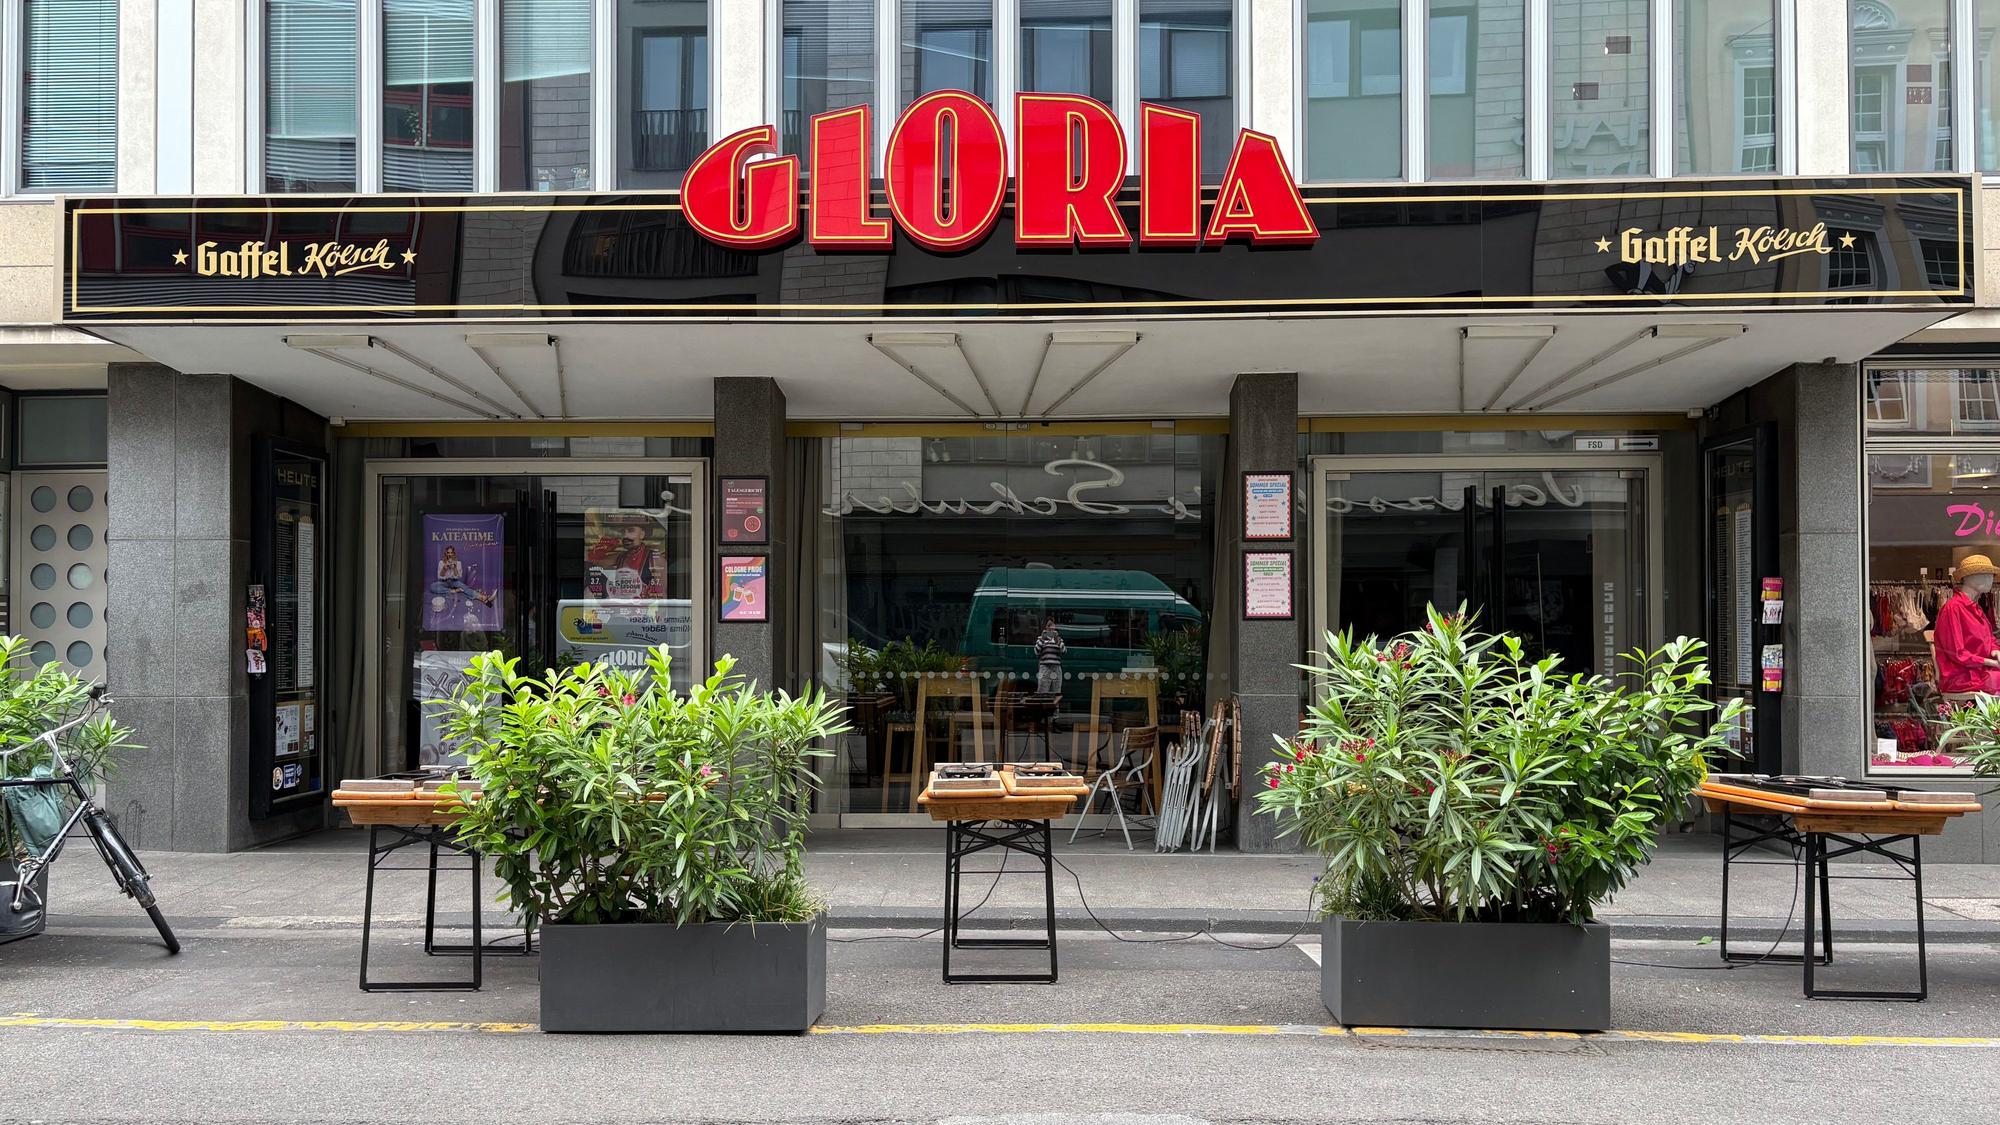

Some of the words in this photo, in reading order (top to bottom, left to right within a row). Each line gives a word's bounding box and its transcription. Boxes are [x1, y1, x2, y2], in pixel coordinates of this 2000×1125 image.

[680, 89, 1320, 252] GLORIA
[1621, 227, 1721, 267] Gaffel
[1728, 221, 1833, 264] Kölsch
[197, 240, 291, 279] Gaffel
[298, 238, 395, 278] Kölsch
[1588, 440, 1603, 449] FSD
[277, 467, 317, 488] HEUTE
[1713, 460, 1752, 478] HEUTE
[432, 532, 494, 541] KATEATIME
